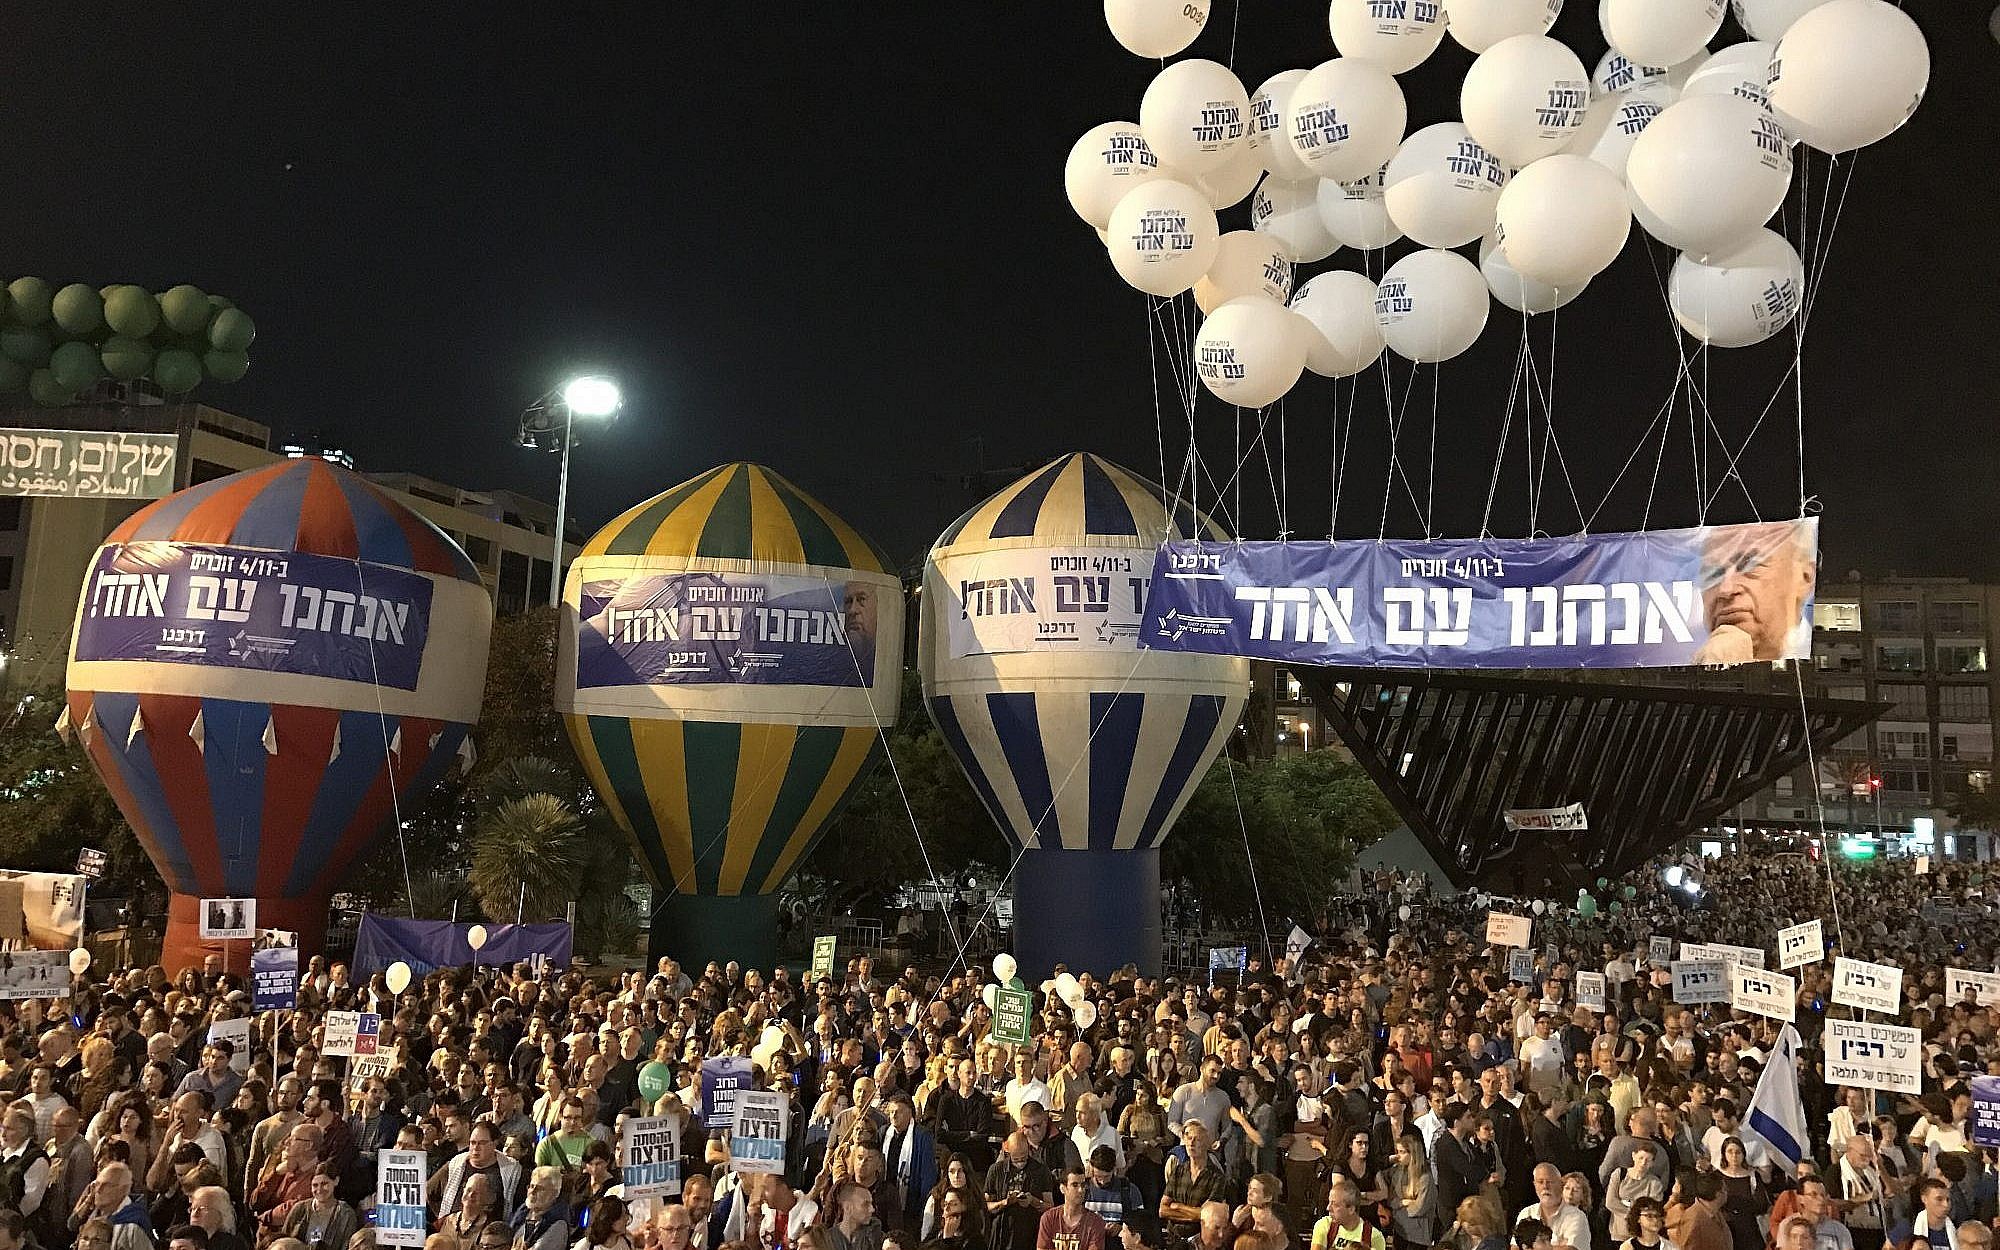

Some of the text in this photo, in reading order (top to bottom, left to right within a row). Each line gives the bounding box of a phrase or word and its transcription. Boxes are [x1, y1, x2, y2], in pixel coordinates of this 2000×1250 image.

[1366, 0, 1438, 23] עם אחד
[1602, 67, 1635, 92] אחד
[1201, 107, 1240, 125] אנחנו
[1259, 113, 1280, 131] עם
[1295, 107, 1337, 132] אנחנו
[1535, 108, 1570, 127] אחד
[1192, 122, 1244, 142] עם אחד
[1324, 123, 1350, 144] עם
[1751, 129, 1783, 156] אחד
[1102, 149, 1158, 168] עם אחד
[1446, 155, 1506, 188] עם אחד
[1140, 217, 1186, 233] אנחנו
[1131, 234, 1195, 250] עם אחד
[1377, 282, 1408, 298] אנחנו
[1392, 297, 1413, 313] עם
[1201, 347, 1236, 364] אנחנו
[1222, 363, 1246, 379] עם
[69, 432, 174, 477] שלום,
[0, 471, 139, 497] السلام مفقود
[189, 552, 289, 578] ב-4/11 זוכרים
[1050, 556, 1132, 572] ב-4/11 זוכרים
[1170, 552, 1222, 570] דרכנו
[1401, 556, 1505, 578] ב-4/11 זוכרים
[687, 585, 765, 603] אנחנו זוכרים
[960, 576, 1037, 621] אחד!
[1053, 575, 1111, 613] עם
[90, 570, 409, 645] אנחנו עם אחד!
[1234, 580, 1695, 647] אנחנו עם אחד
[606, 606, 847, 646] אנחנו עם אחד!
[1037, 621, 1076, 634] דרכנו
[161, 627, 207, 645] דרכנו
[1785, 935, 1806, 953] רבין
[1681, 972, 1708, 989] רבין
[1743, 978, 1771, 996] רבין
[1844, 971, 1876, 988] רבין
[328, 1013, 359, 1026] לשלום
[364, 1018, 378, 1032] כן
[1000, 1020, 1021, 1030] אחת
[1832, 1021, 1915, 1043] ממשיכים בדרכו
[1841, 1039, 1907, 1061] של רבין
[1831, 1065, 1915, 1086] החברים של תלמה
[632, 1130, 672, 1147] ההסתה
[739, 1118, 781, 1140] הרצח
[630, 1142, 674, 1166] הרצח
[385, 1167, 419, 1183] ההסתה
[624, 1163, 677, 1187] השלום
[383, 1182, 421, 1206] הרצח
